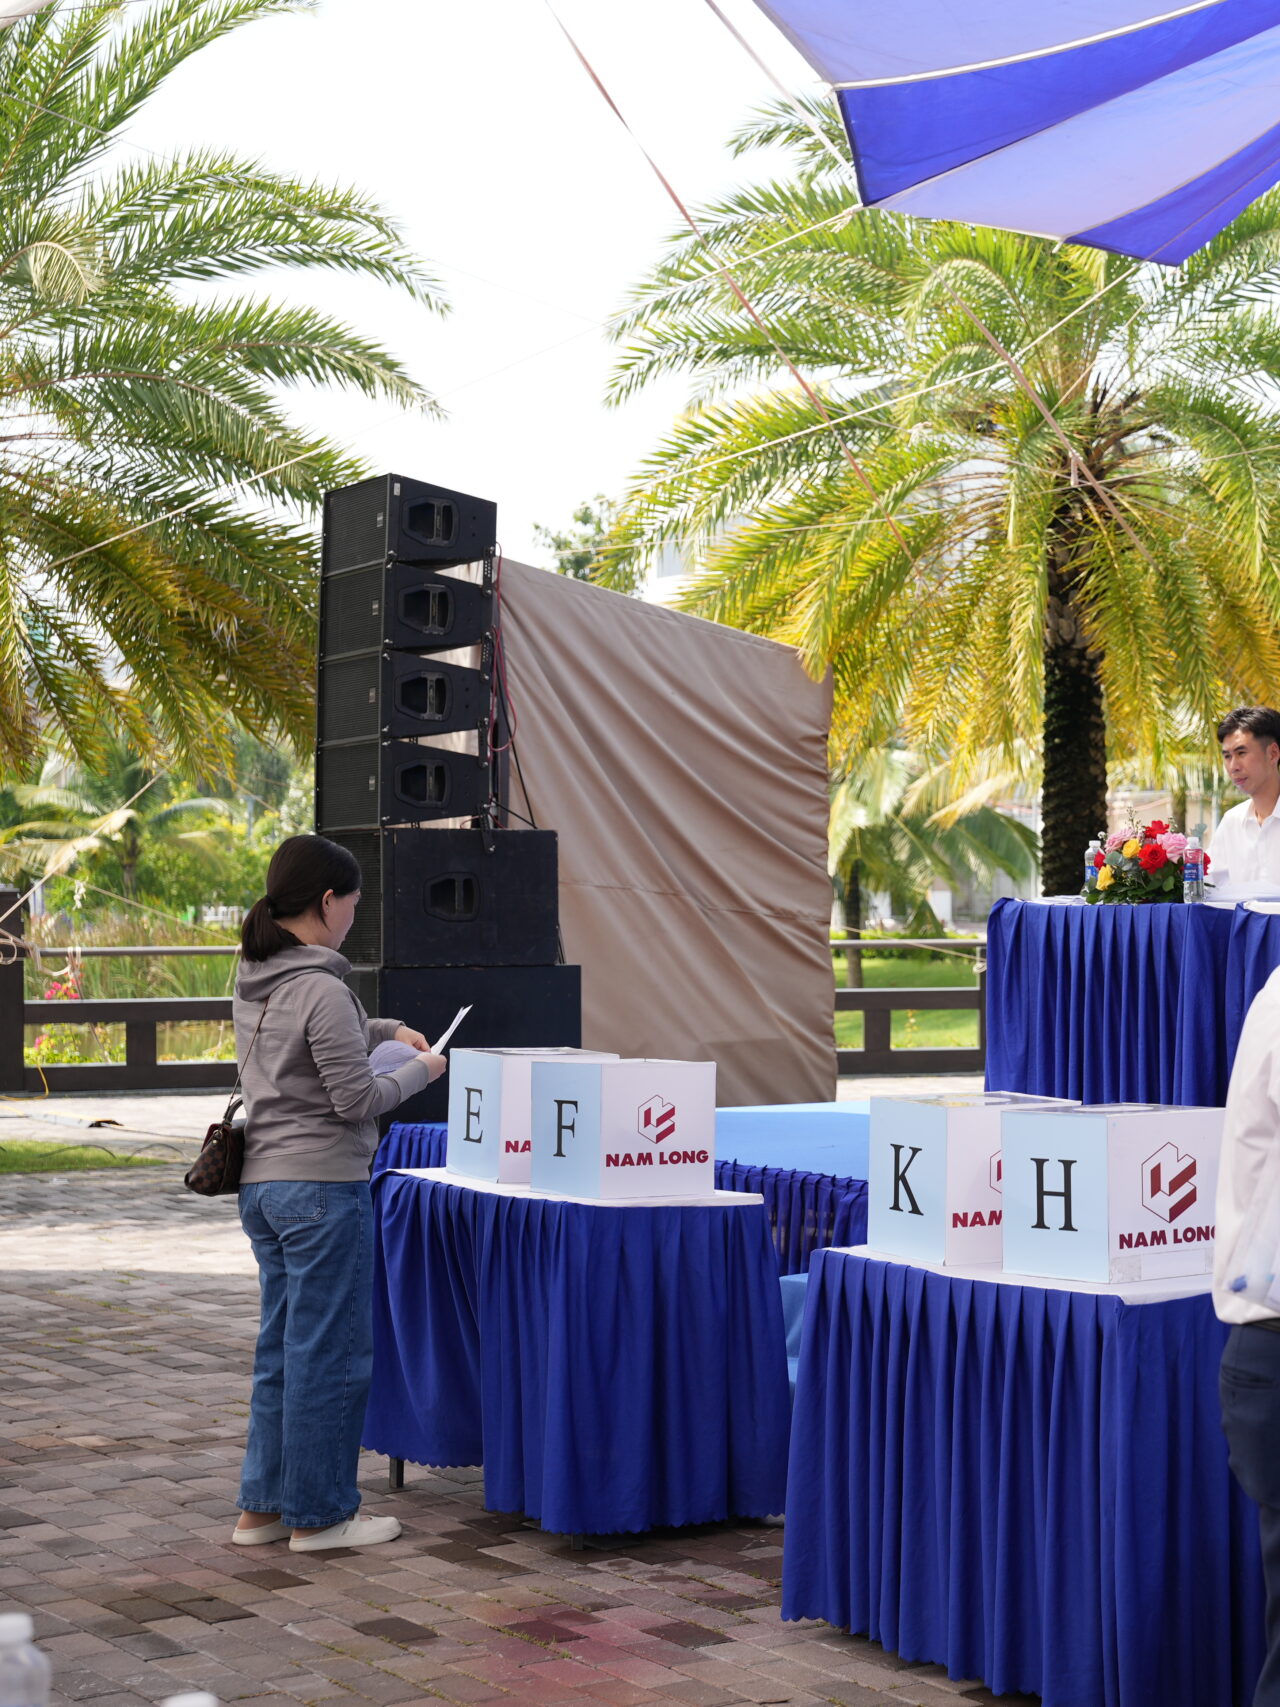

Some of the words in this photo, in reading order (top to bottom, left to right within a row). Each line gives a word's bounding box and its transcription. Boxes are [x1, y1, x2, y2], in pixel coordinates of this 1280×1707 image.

[463, 1087, 483, 1144] E
[553, 1099, 578, 1157] F
[505, 1140, 531, 1153] NA
[606, 1152, 653, 1167] NAM
[660, 1150, 709, 1164] LONG
[890, 1143, 924, 1216] K
[1030, 1158, 1078, 1232] H
[952, 1210, 1002, 1228] NAM
[1119, 1228, 1167, 1249] NAM
[1173, 1225, 1215, 1244] LON
